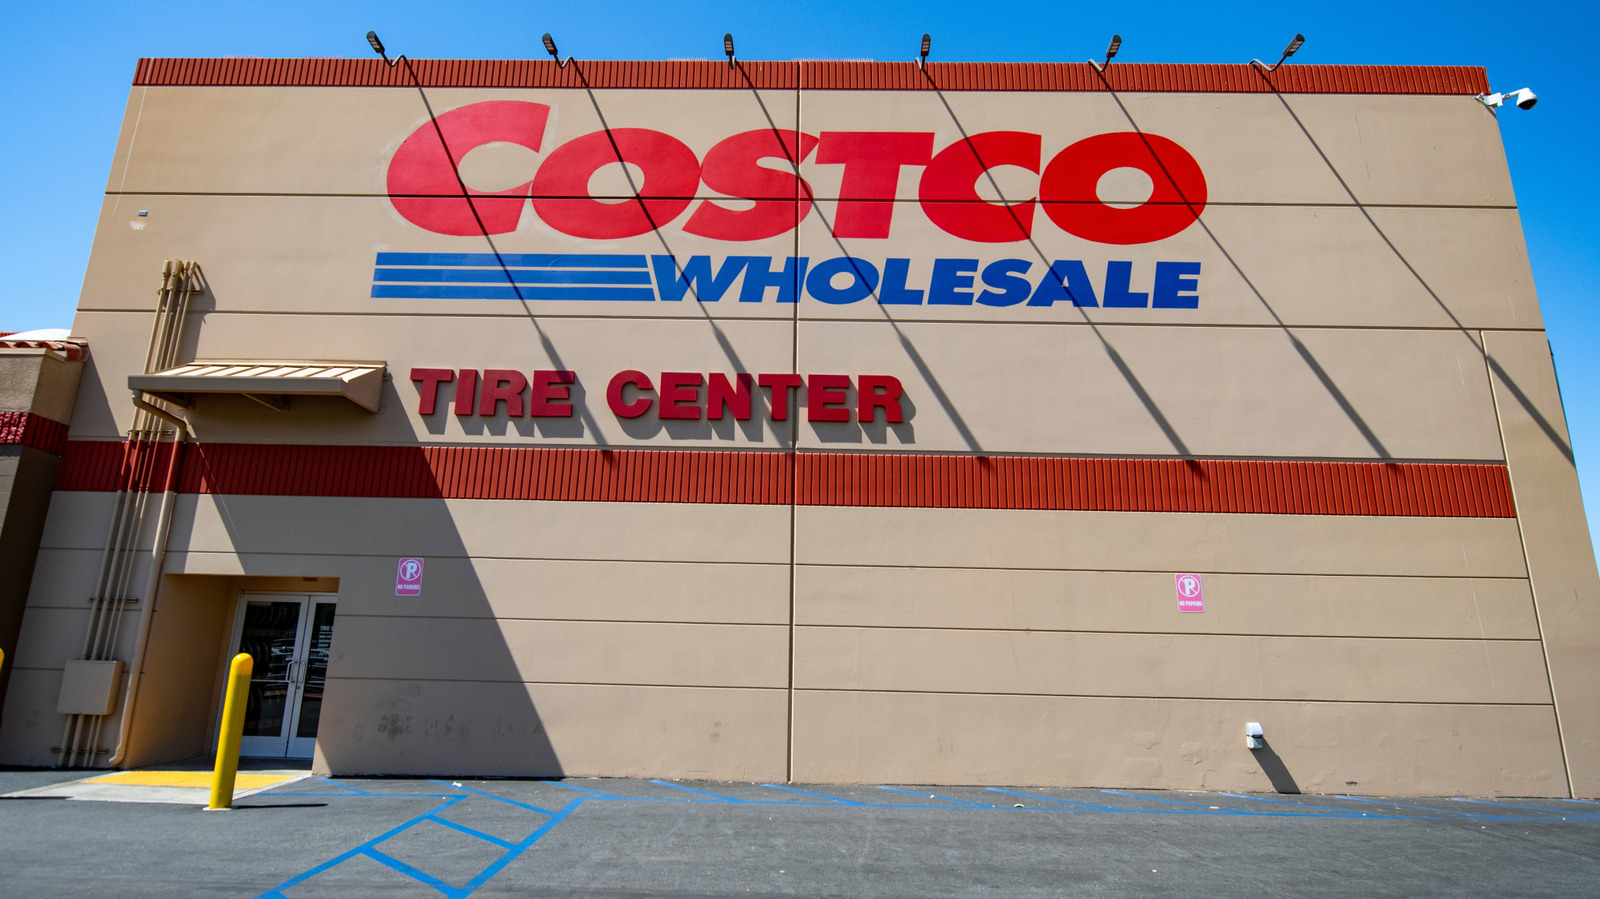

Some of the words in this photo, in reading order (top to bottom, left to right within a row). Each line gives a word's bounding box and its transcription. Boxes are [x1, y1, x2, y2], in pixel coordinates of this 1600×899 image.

[386, 100, 1207, 245] COSTCO
[651, 254, 1201, 309] WHOLESALE
[410, 368, 576, 418] TIRE
[606, 369, 904, 424] CENTER
